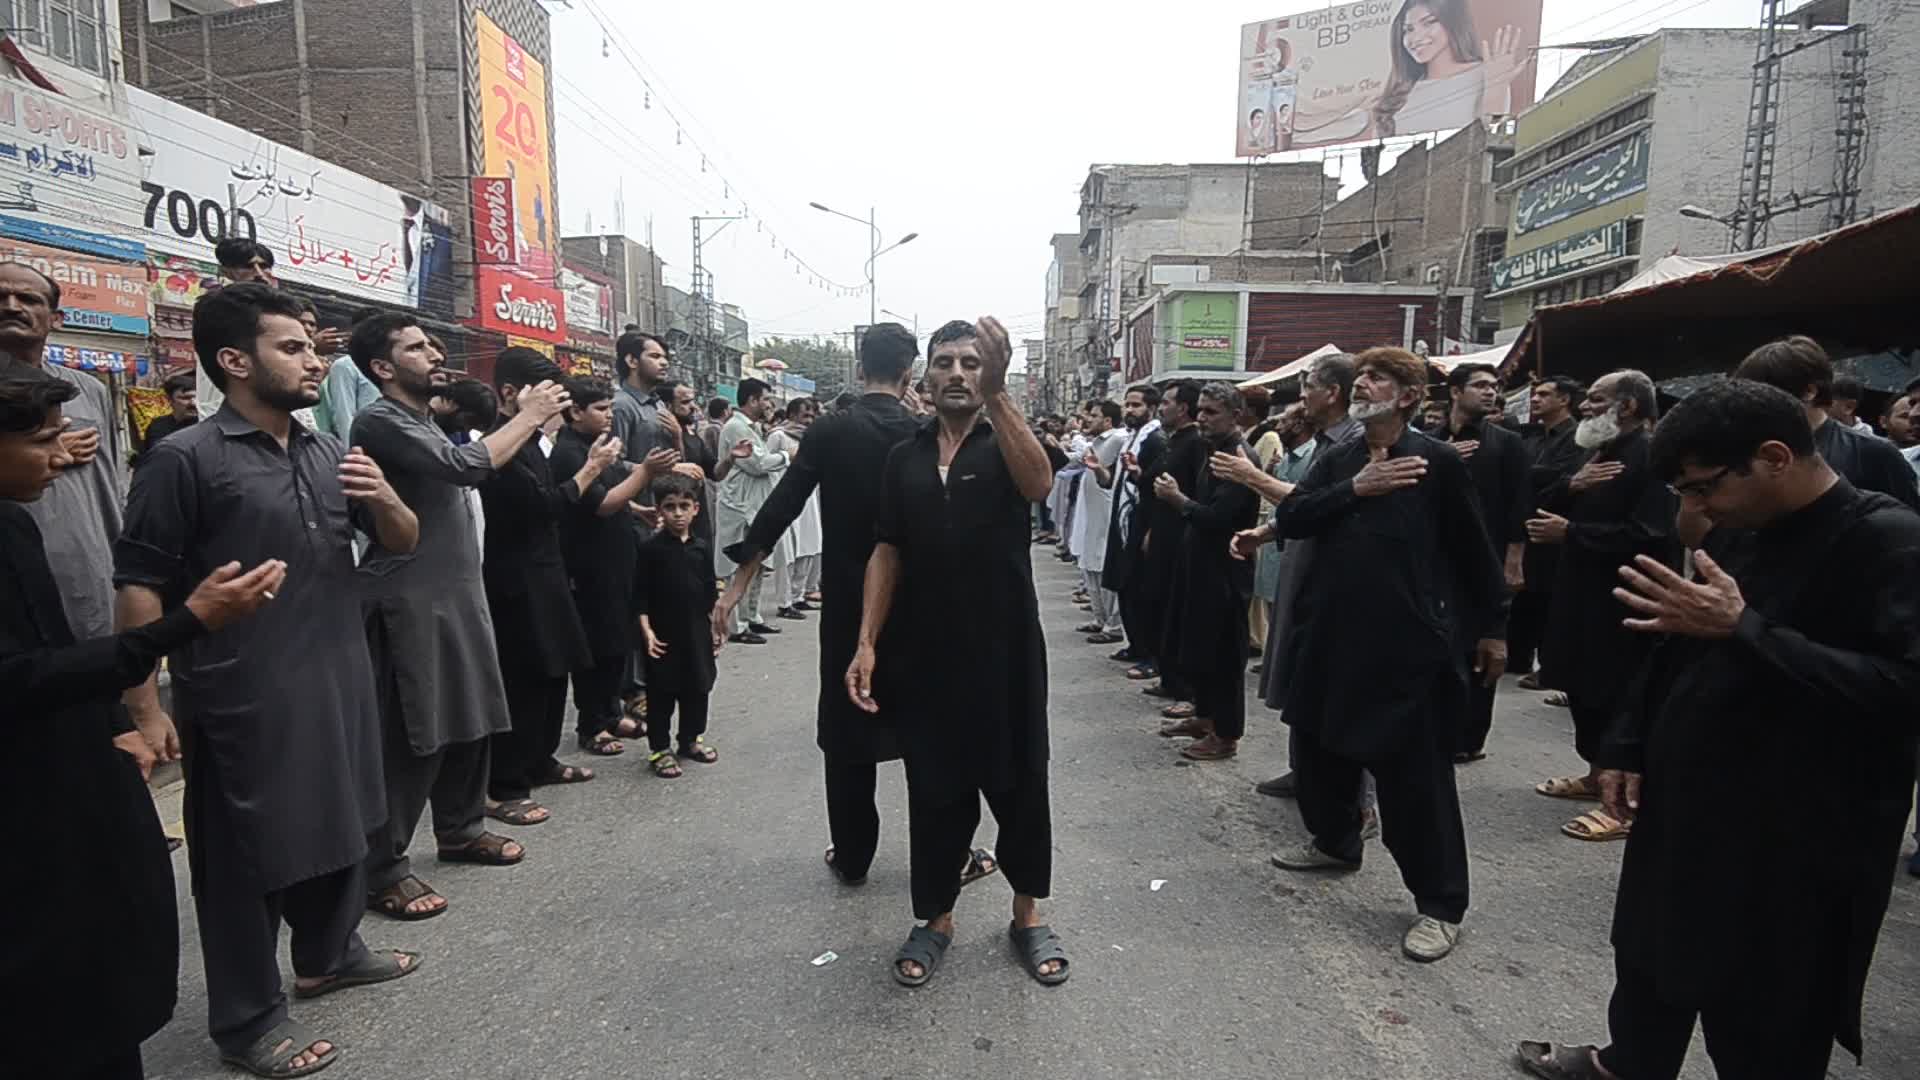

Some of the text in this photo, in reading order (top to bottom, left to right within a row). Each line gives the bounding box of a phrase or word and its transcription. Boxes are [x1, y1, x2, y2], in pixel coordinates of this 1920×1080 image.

[1297, 1, 1393, 30] Light & Glow
[1317, 24, 1350, 48] BB
[23, 95, 127, 159] SPORTS
[494, 84, 537, 156] 20
[486, 180, 508, 261] Servis
[104, 272, 145, 296] Max
[73, 308, 112, 327] Center
[495, 283, 557, 331] Servis
